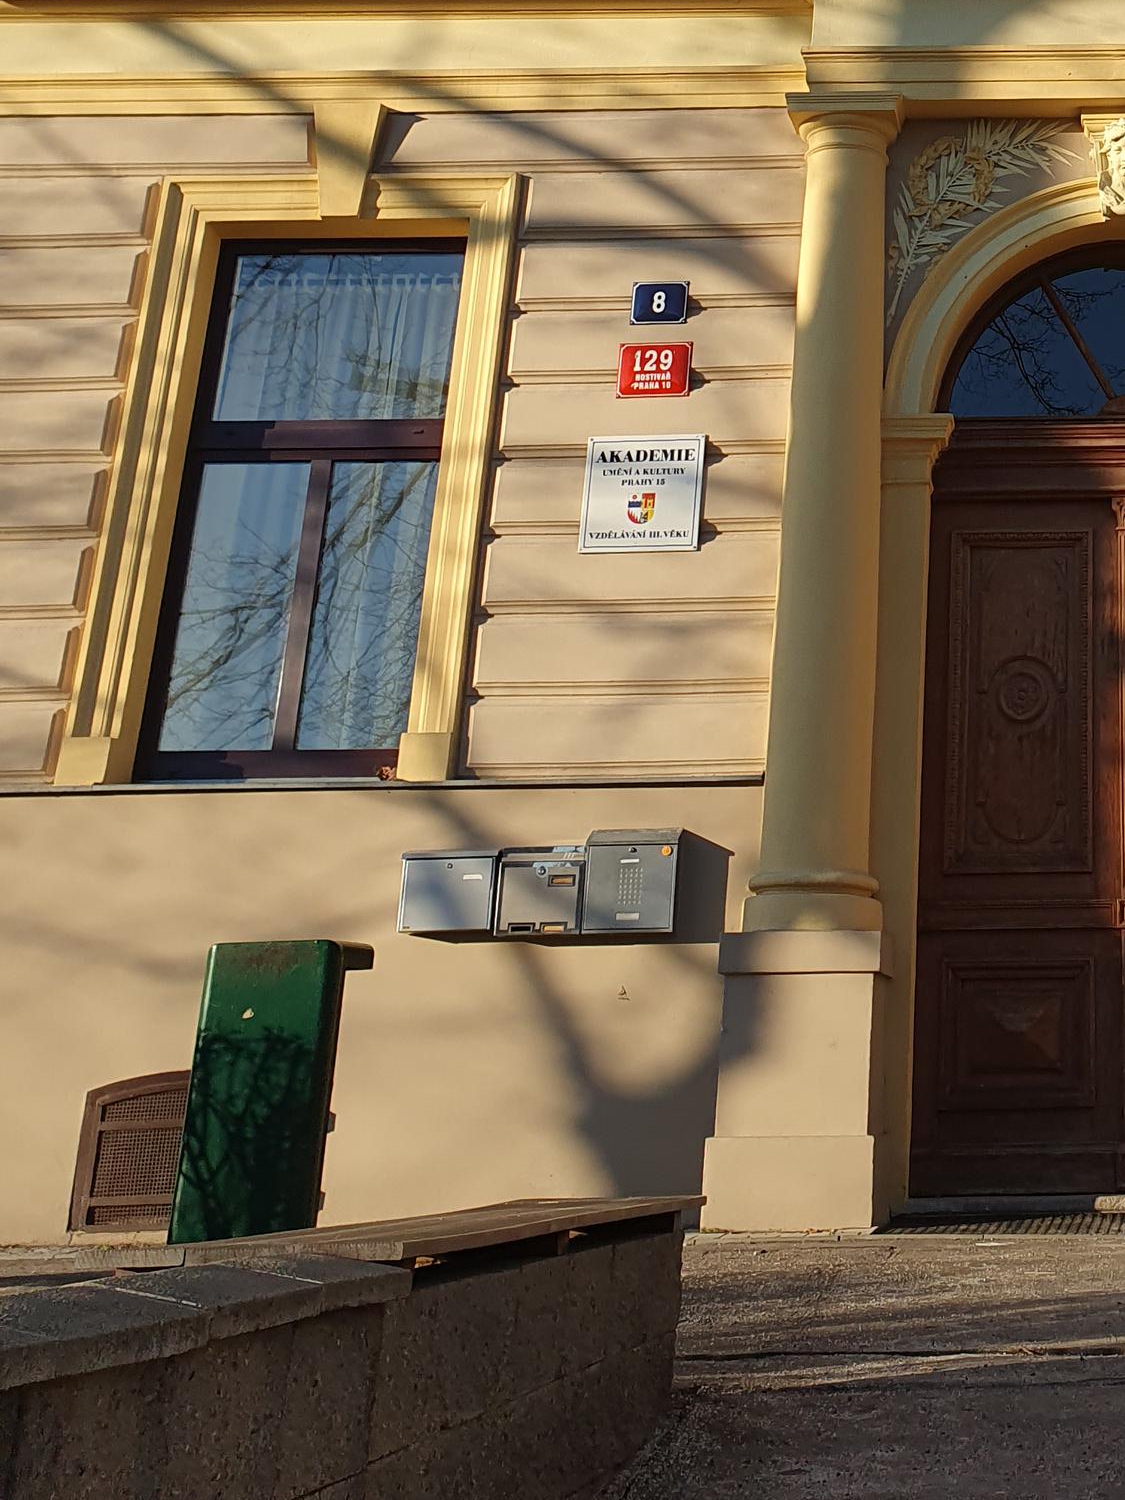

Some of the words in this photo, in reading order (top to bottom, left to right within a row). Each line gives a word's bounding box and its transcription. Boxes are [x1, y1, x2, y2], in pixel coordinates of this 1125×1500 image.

[652, 291, 666, 314] 8
[633, 349, 673, 372] 129
[632, 381, 660, 390] PRAHA
[662, 381, 671, 389] 10
[595, 448, 696, 463] AKADEMIE
[634, 468, 641, 476] A
[643, 467, 687, 476] KULTURY
[655, 478, 666, 486] 15
[588, 529, 646, 539] VZDĚLÁVÁNÍ
